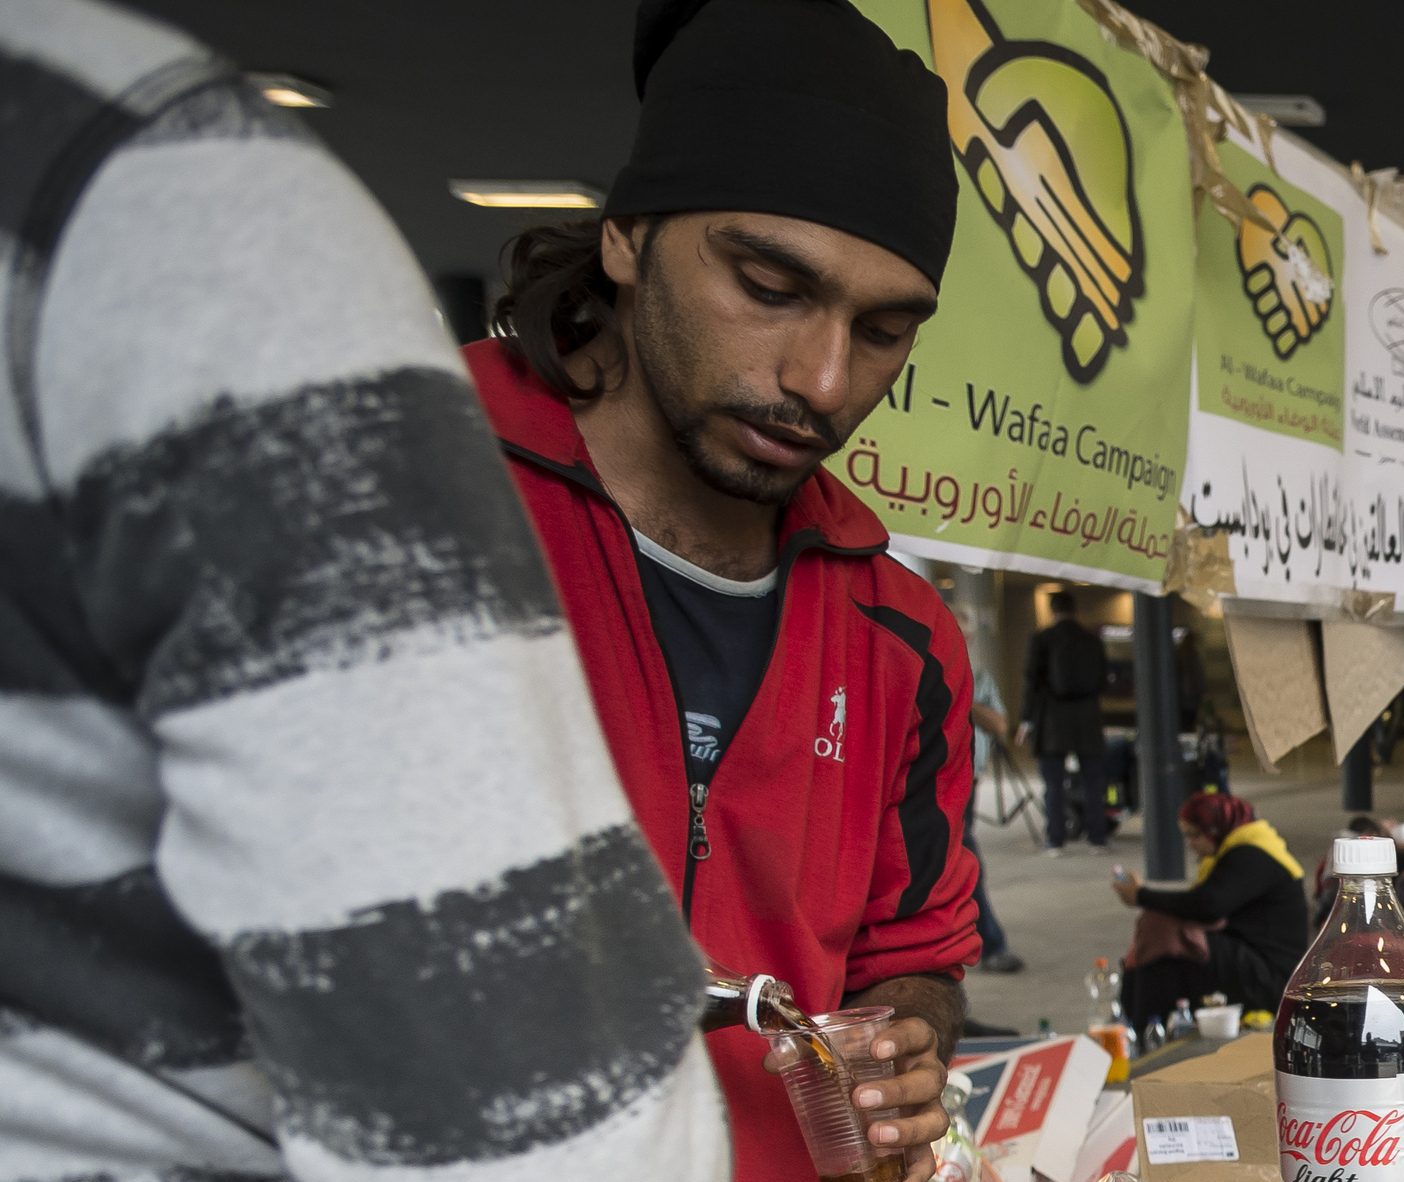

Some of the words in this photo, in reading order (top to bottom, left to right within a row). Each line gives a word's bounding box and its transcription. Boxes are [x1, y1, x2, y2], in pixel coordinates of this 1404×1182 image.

[845, 437, 1034, 530] الأوروبية
[966, 382, 1068, 457] Wafaa
[1075, 425, 1177, 500] Campaign
[1029, 491, 1118, 549] الوفاء
